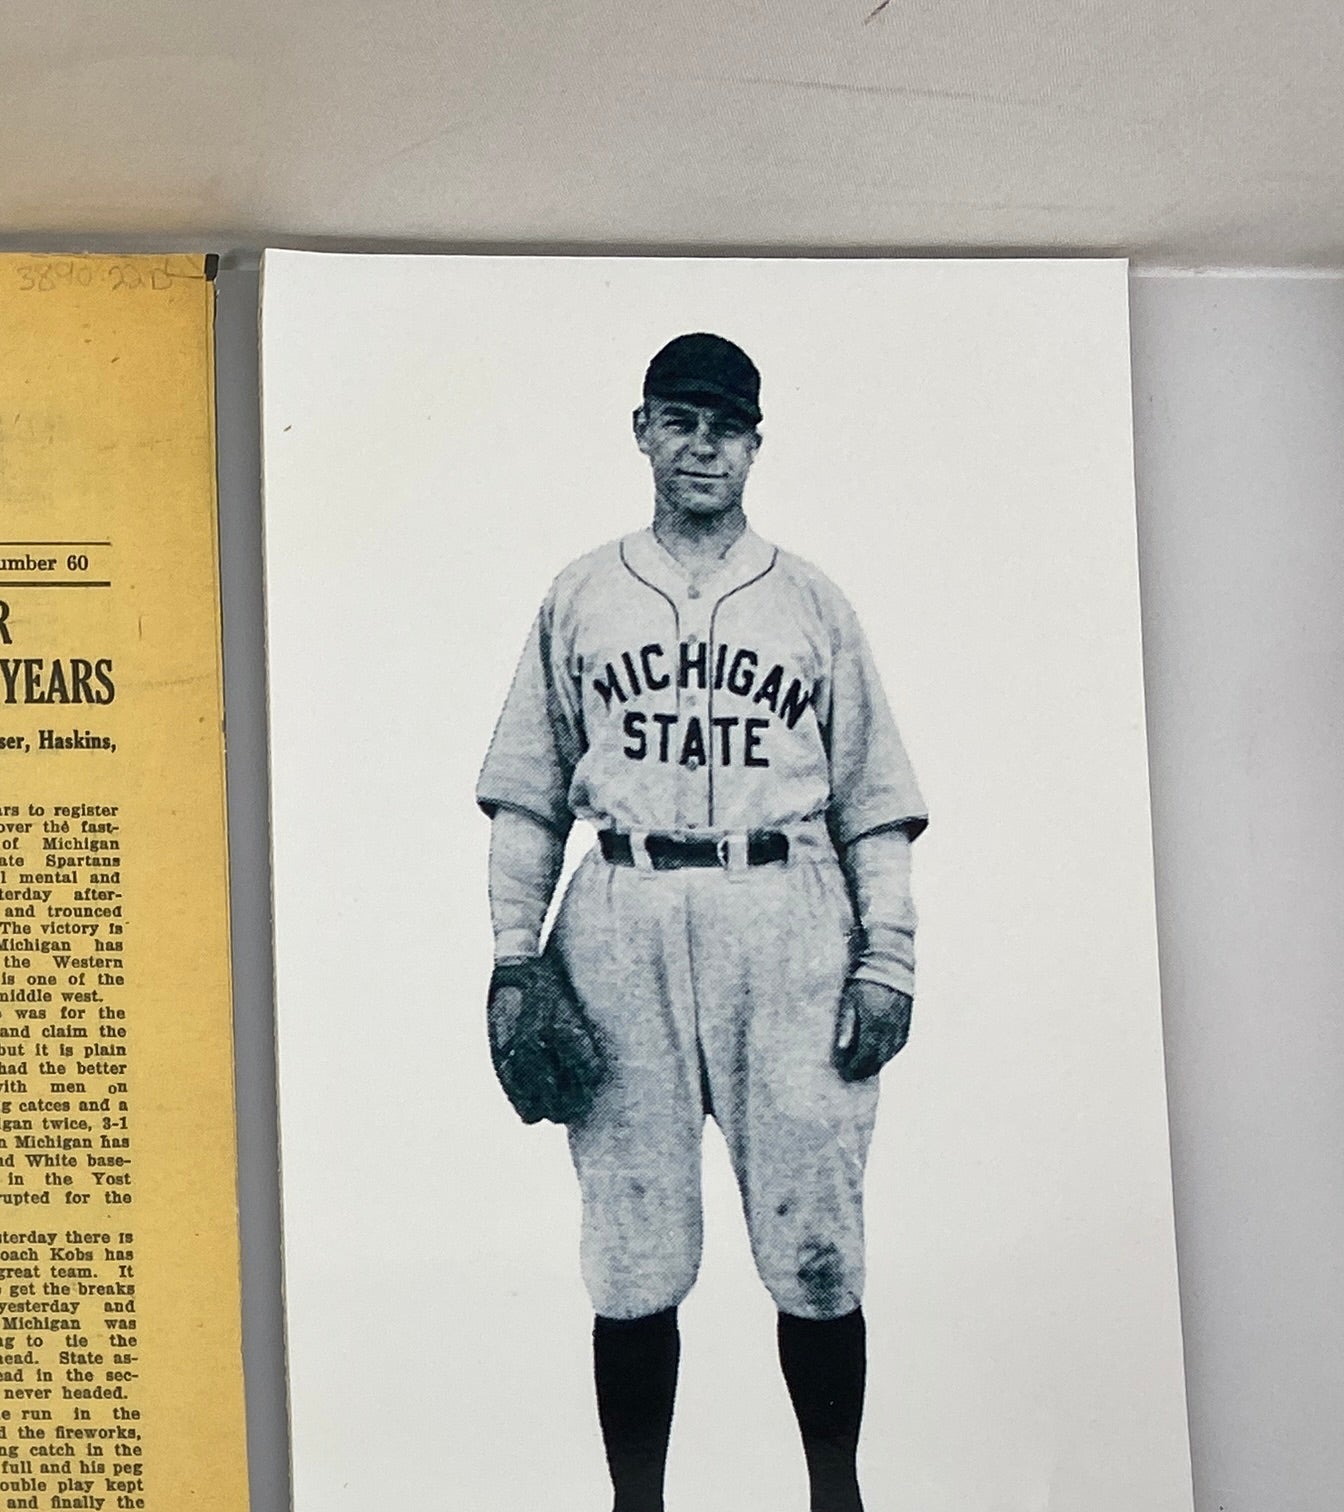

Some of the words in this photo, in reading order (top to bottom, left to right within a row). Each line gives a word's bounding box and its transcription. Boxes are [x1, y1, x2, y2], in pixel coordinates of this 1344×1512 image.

[66, 554, 89, 572] 60
[592, 642, 817, 730] MICHIGAN
[37, 728, 117, 754] Haskins,
[623, 711, 771, 768] STATE
[27, 803, 45, 817] to
[53, 802, 120, 819] register
